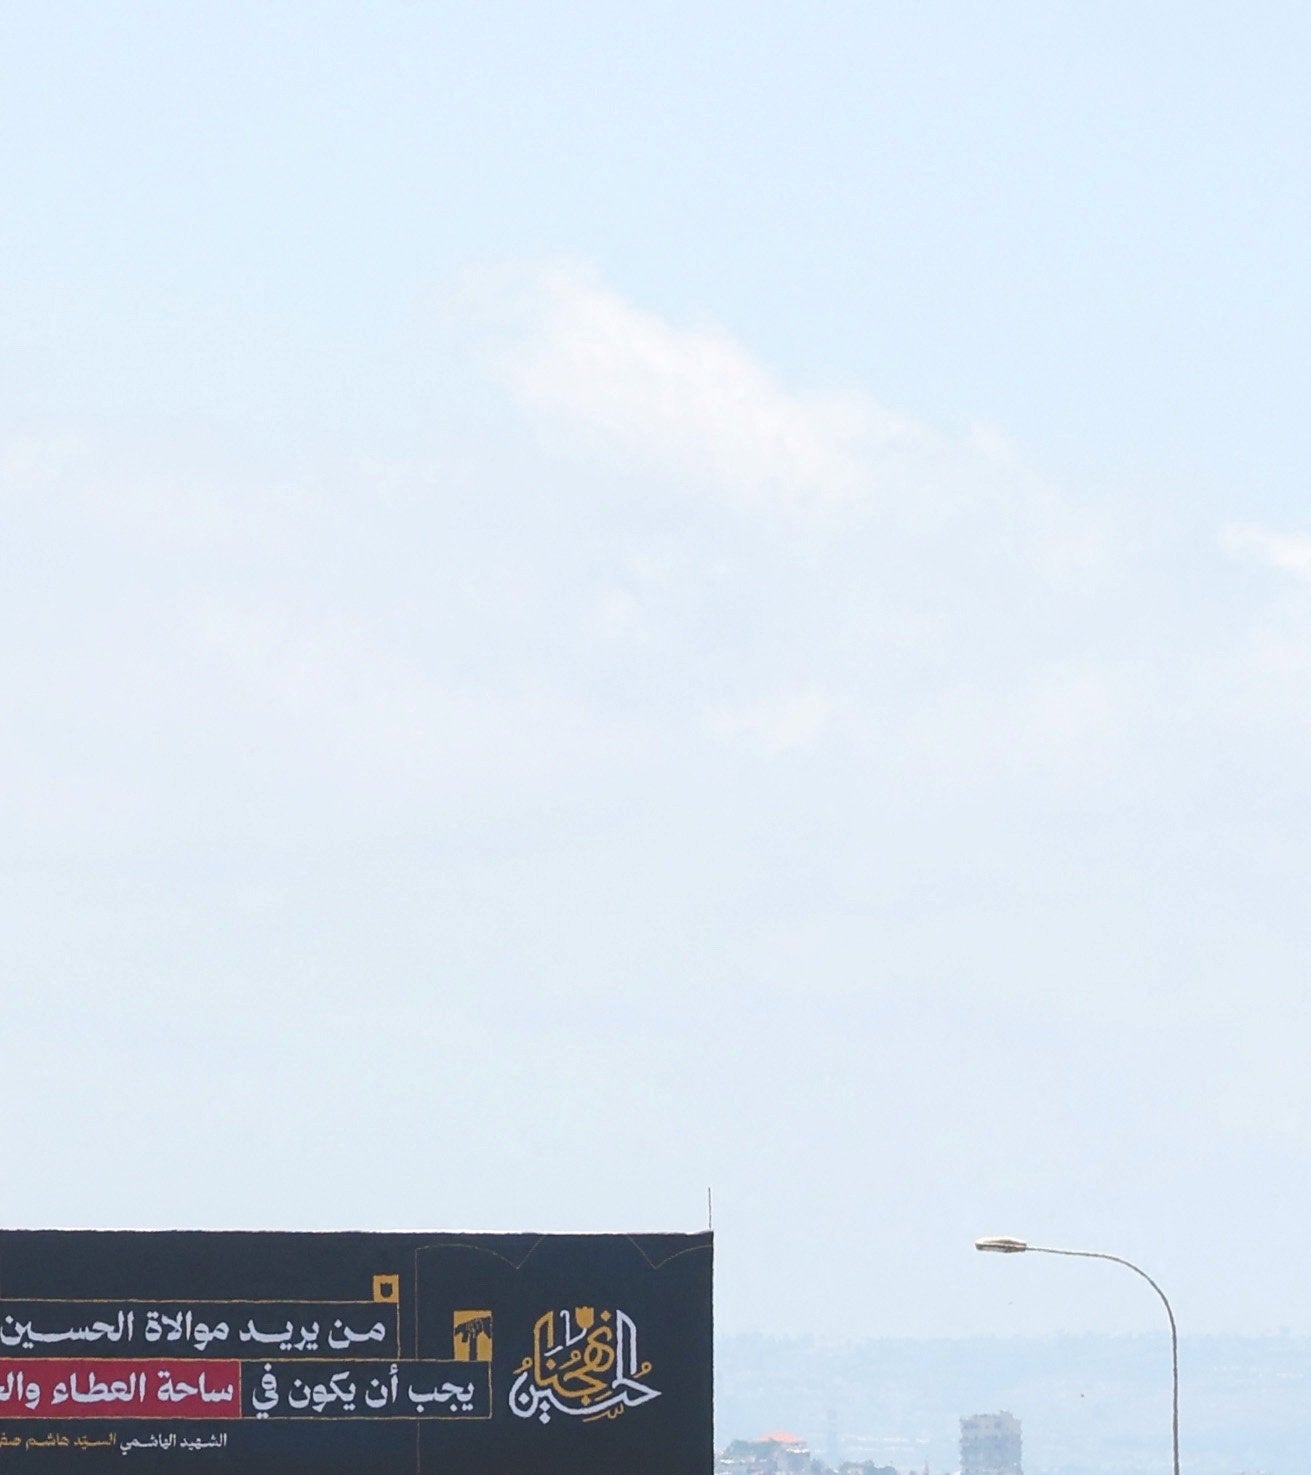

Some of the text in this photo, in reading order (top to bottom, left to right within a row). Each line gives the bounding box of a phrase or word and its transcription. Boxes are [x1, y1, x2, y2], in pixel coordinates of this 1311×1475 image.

[145, 1311, 230, 1350] موالاة
[239, 1319, 320, 1350] يريد
[328, 1320, 385, 1348] من
[51, 1363, 475, 1419] يجب أن يكون في ساحة العطاء
